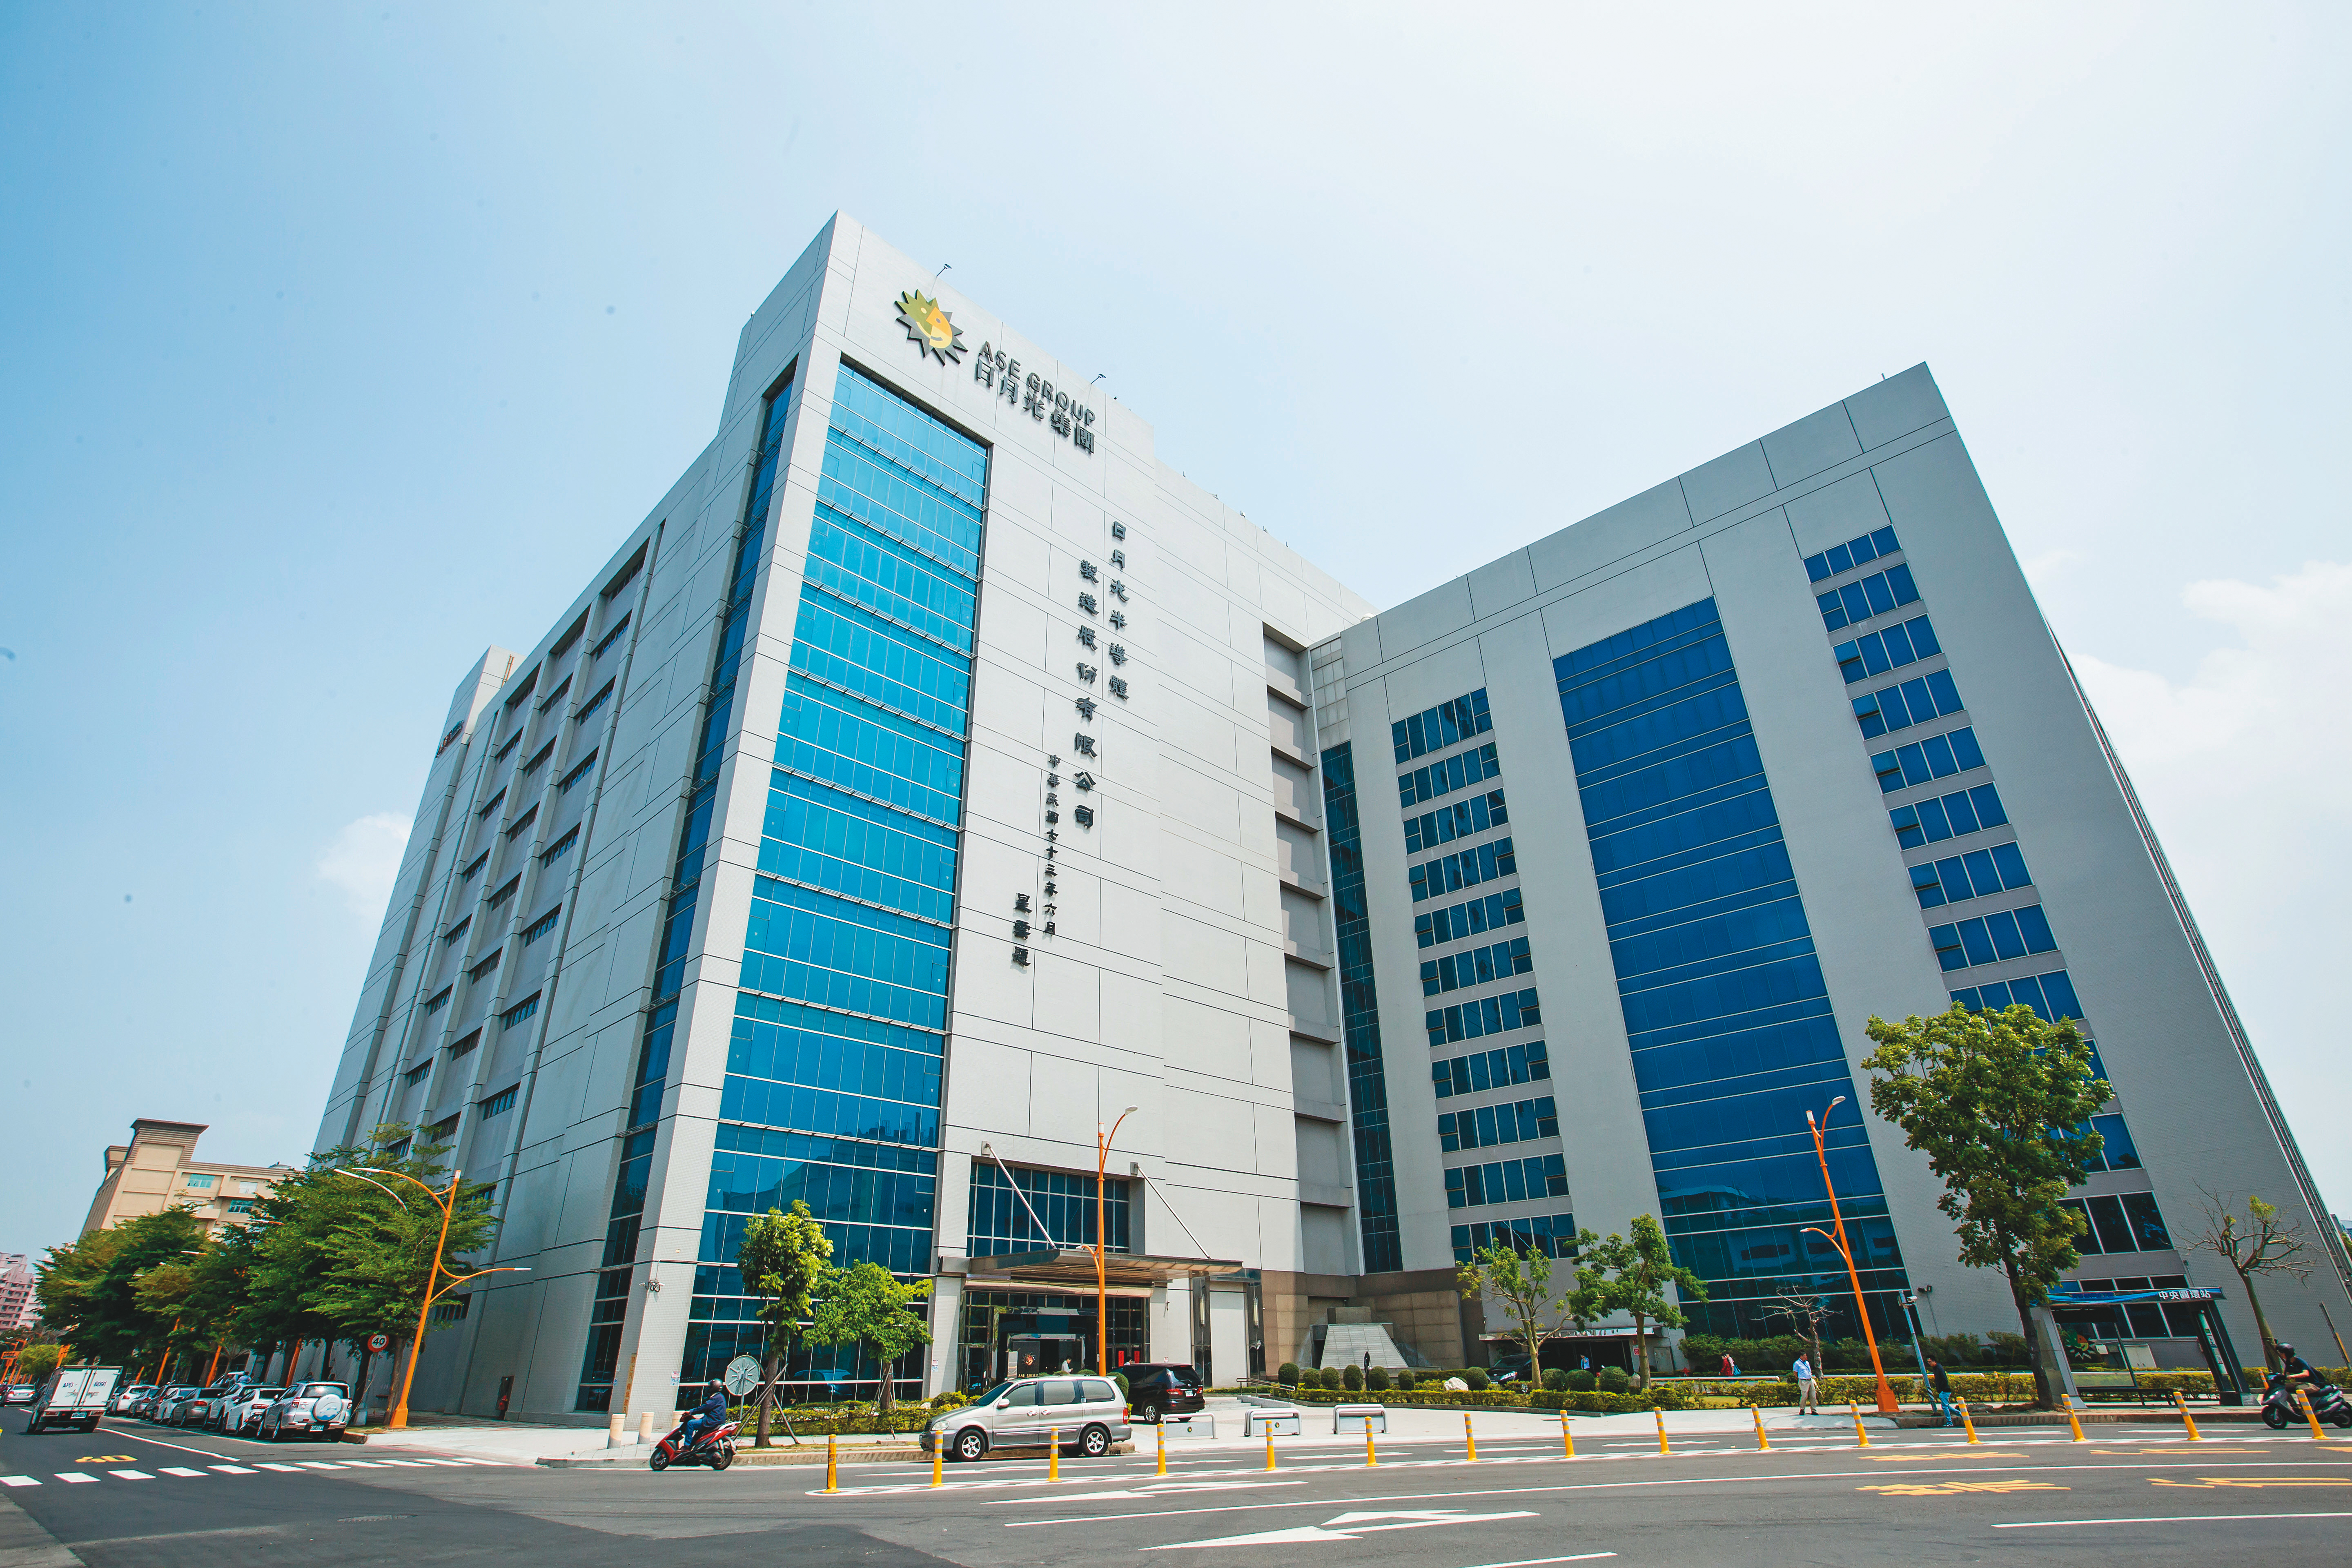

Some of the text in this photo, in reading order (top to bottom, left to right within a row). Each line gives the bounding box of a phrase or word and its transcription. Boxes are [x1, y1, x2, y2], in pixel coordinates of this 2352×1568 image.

[976, 358, 1095, 454] 日月光集團
[979, 341, 1096, 426] ASE GROUP
[1109, 521, 1130, 701] 日月光半導體
[1074, 559, 1099, 829] 製造股份有限公司
[1043, 754, 1061, 935] 中華民國七十三年六月
[75, 1454, 138, 1463] 40
